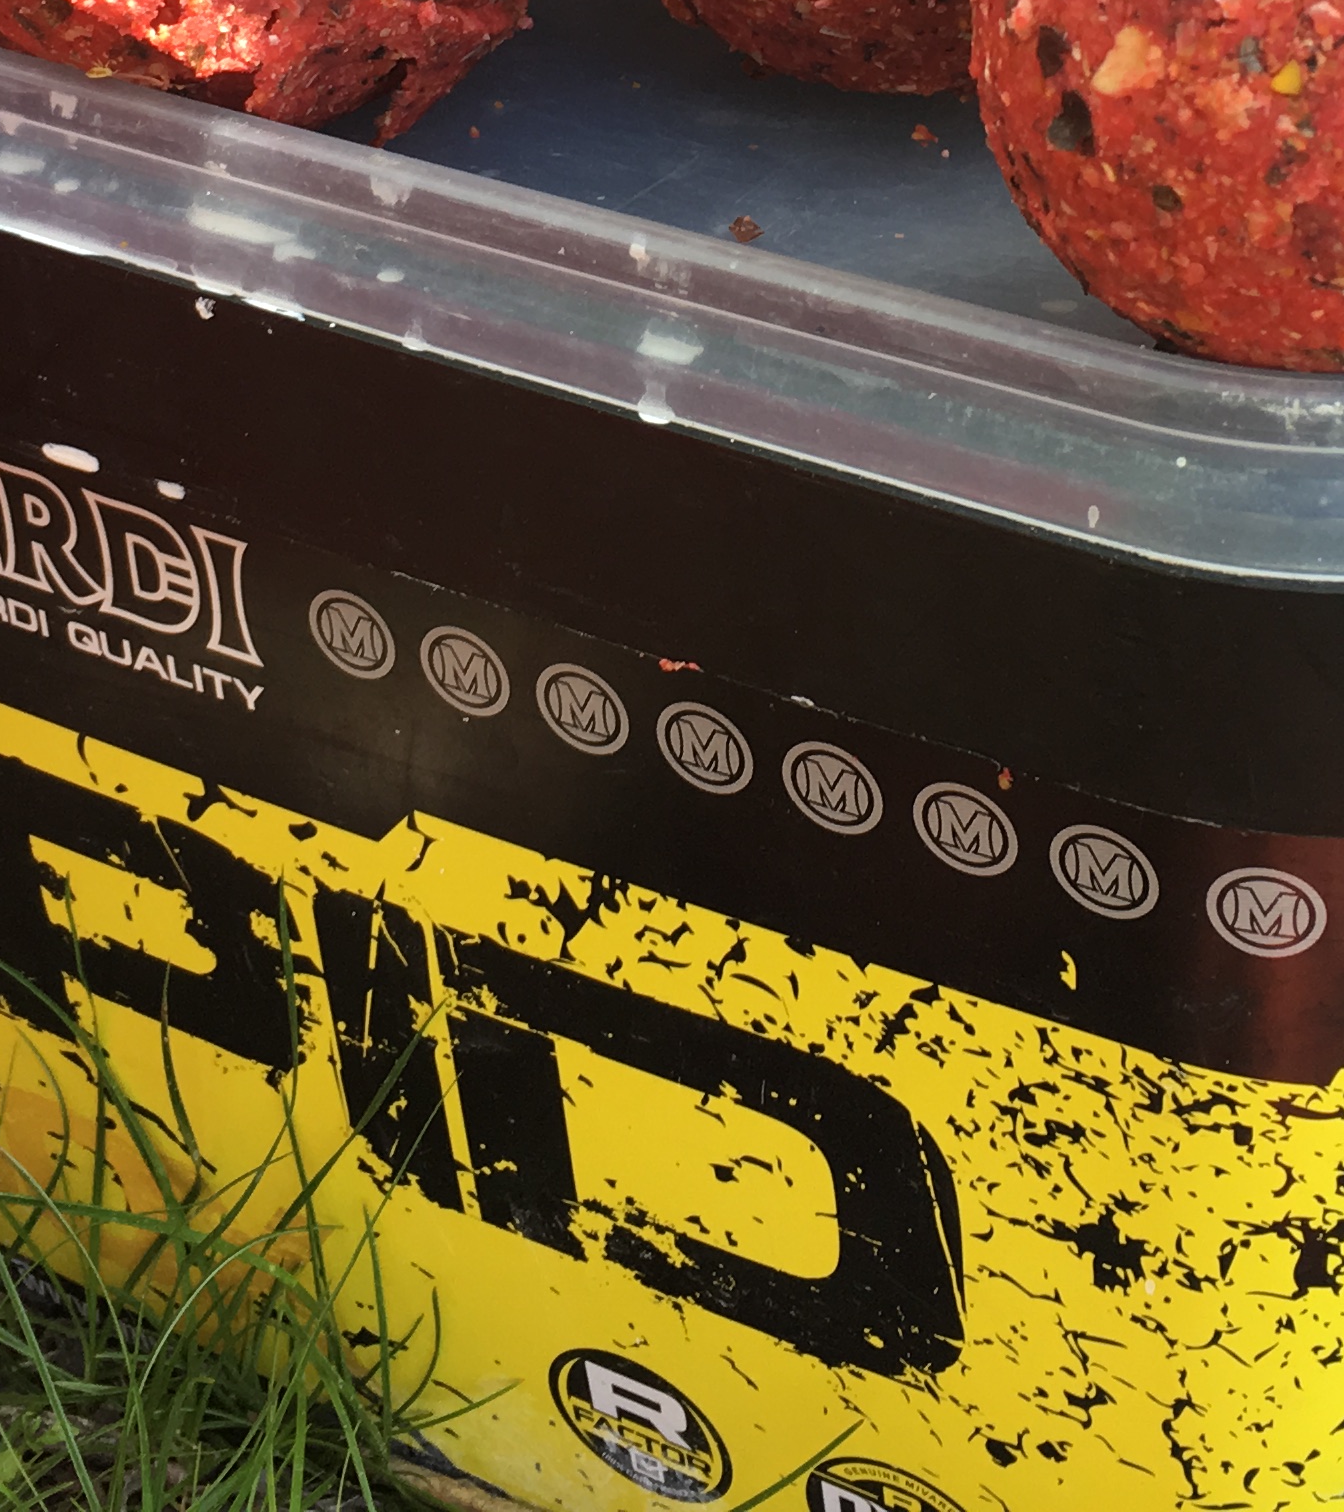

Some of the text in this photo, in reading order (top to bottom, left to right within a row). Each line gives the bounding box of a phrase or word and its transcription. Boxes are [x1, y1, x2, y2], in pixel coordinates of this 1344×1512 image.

[67, 620, 264, 711] QUALITY
[572, 1403, 712, 1480] FACTOR
[585, 1360, 692, 1451] R
